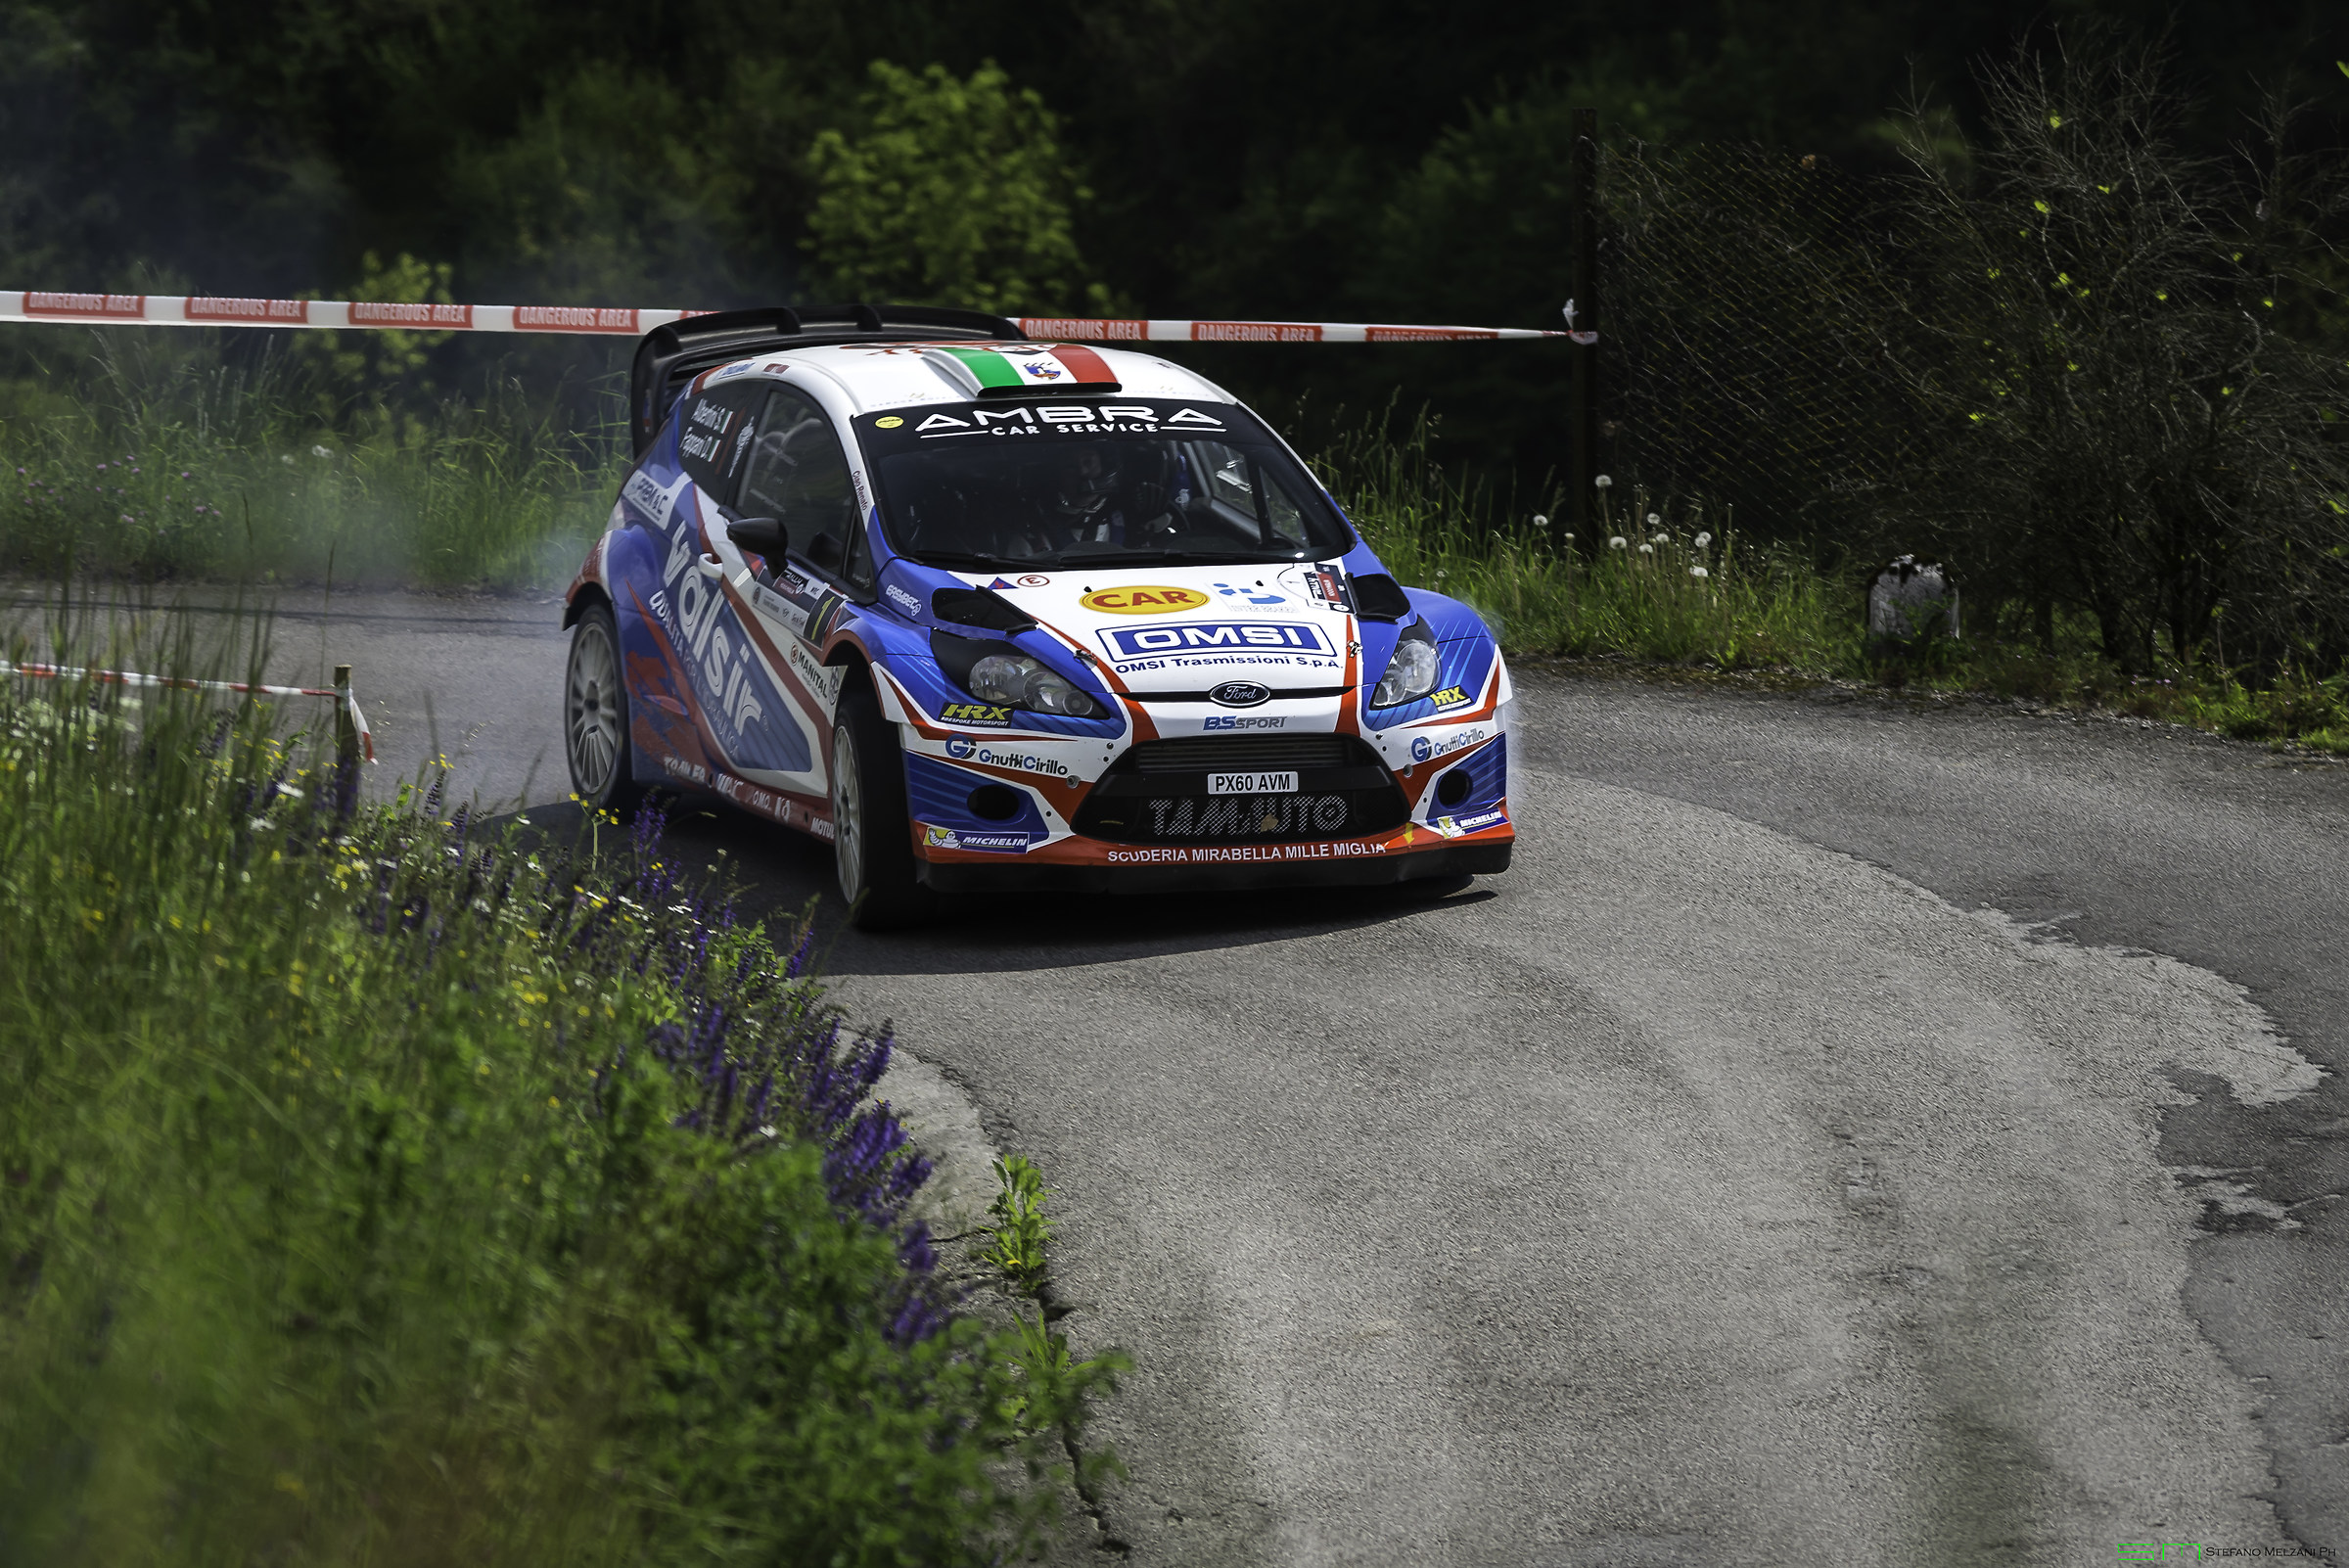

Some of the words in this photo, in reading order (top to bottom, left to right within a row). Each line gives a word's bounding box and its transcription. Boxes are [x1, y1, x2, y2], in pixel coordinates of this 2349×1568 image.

[29, 293, 102, 311] DANGEROUS
[106, 295, 137, 312] AREA
[191, 298, 264, 316] DANGEROUS
[268, 300, 301, 317] AREA
[354, 302, 430, 321] DANGEROUS
[433, 304, 466, 322] AREA
[519, 307, 595, 326] DANGEROUS
[599, 308, 632, 327] AREA
[1027, 319, 1104, 340] DANGEROUS
[1107, 321, 1141, 340] AREA
[1197, 324, 1277, 342] DANGEROUS
[1280, 325, 1314, 342] AREA
[915, 406, 1222, 432] AMBRA
[991, 426, 1040, 436] CAR
[1056, 423, 1160, 435] SERVICE
[852, 470, 861, 488] Ciao
[856, 485, 868, 511] Renato
[1091, 590, 1190, 611] CAR
[809, 595, 836, 641] 1
[664, 520, 763, 736] valsir
[1133, 626, 1303, 650] OMSI
[1115, 660, 1166, 673] OMSI
[1171, 655, 1290, 667] Trasmissioni
[1296, 657, 1344, 669] S.p.A.
[798, 651, 827, 699] MANITAL
[1223, 685, 1257, 700] Ford
[1429, 685, 1465, 707] HRX
[943, 704, 1012, 719] HRX
[1216, 775, 1254, 791] PX60
[1258, 774, 1290, 791] AVM
[1459, 810, 1503, 828] MICHELIN
[962, 836, 1028, 847] MICHELIN
[1108, 850, 1188, 862] SCUDERIA
[1191, 847, 1282, 861] MIRABELLA
[1285, 844, 1330, 858] MILLE
[1334, 843, 1386, 856] MIGLIA
